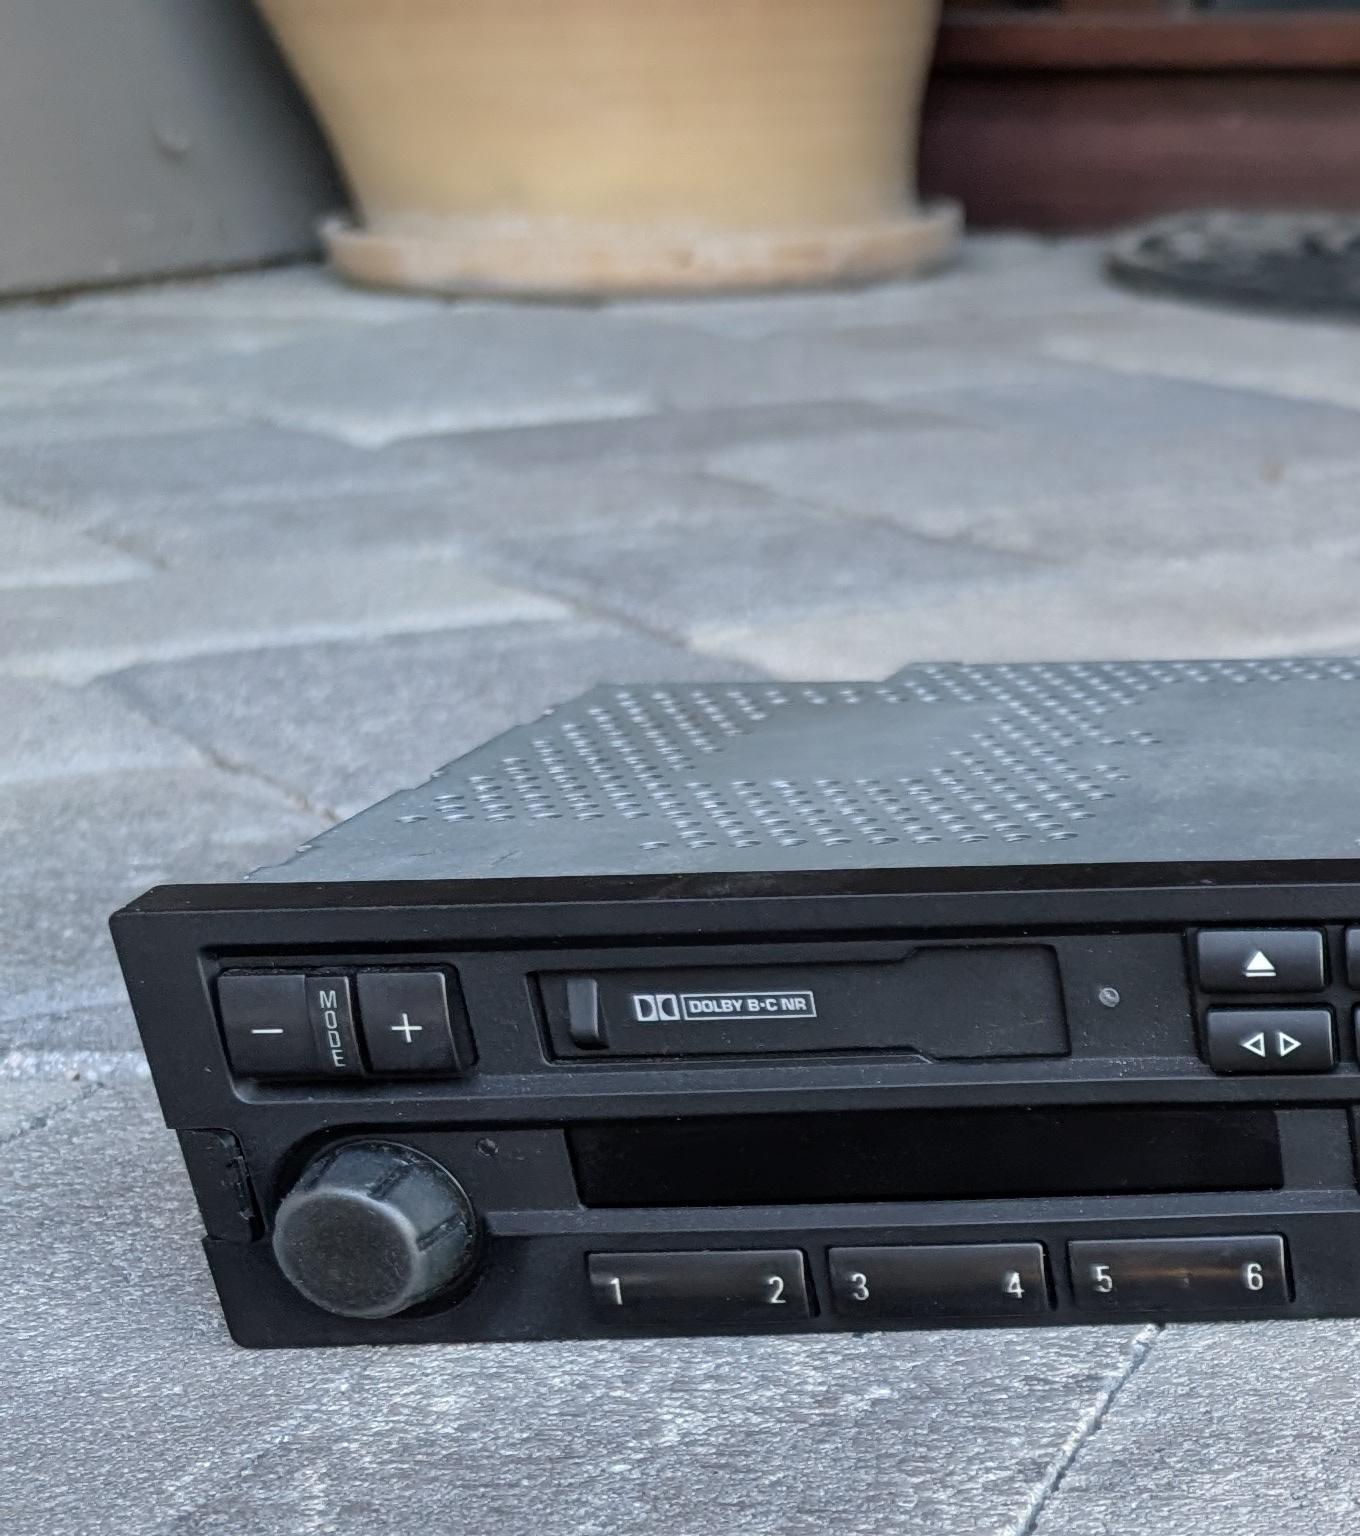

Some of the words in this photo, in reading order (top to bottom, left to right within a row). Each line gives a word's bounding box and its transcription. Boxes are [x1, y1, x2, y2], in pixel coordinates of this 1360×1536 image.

[690, 1000, 742, 1014] DOLBY
[782, 997, 807, 1011] NR
[319, 988, 350, 1068] MODE
[609, 1276, 623, 1306] 1
[767, 1275, 787, 1305] 2
[850, 1271, 871, 1301] 3
[1006, 1270, 1025, 1299] 4
[1094, 1264, 1113, 1294] 5
[1245, 1261, 1264, 1292] 6
